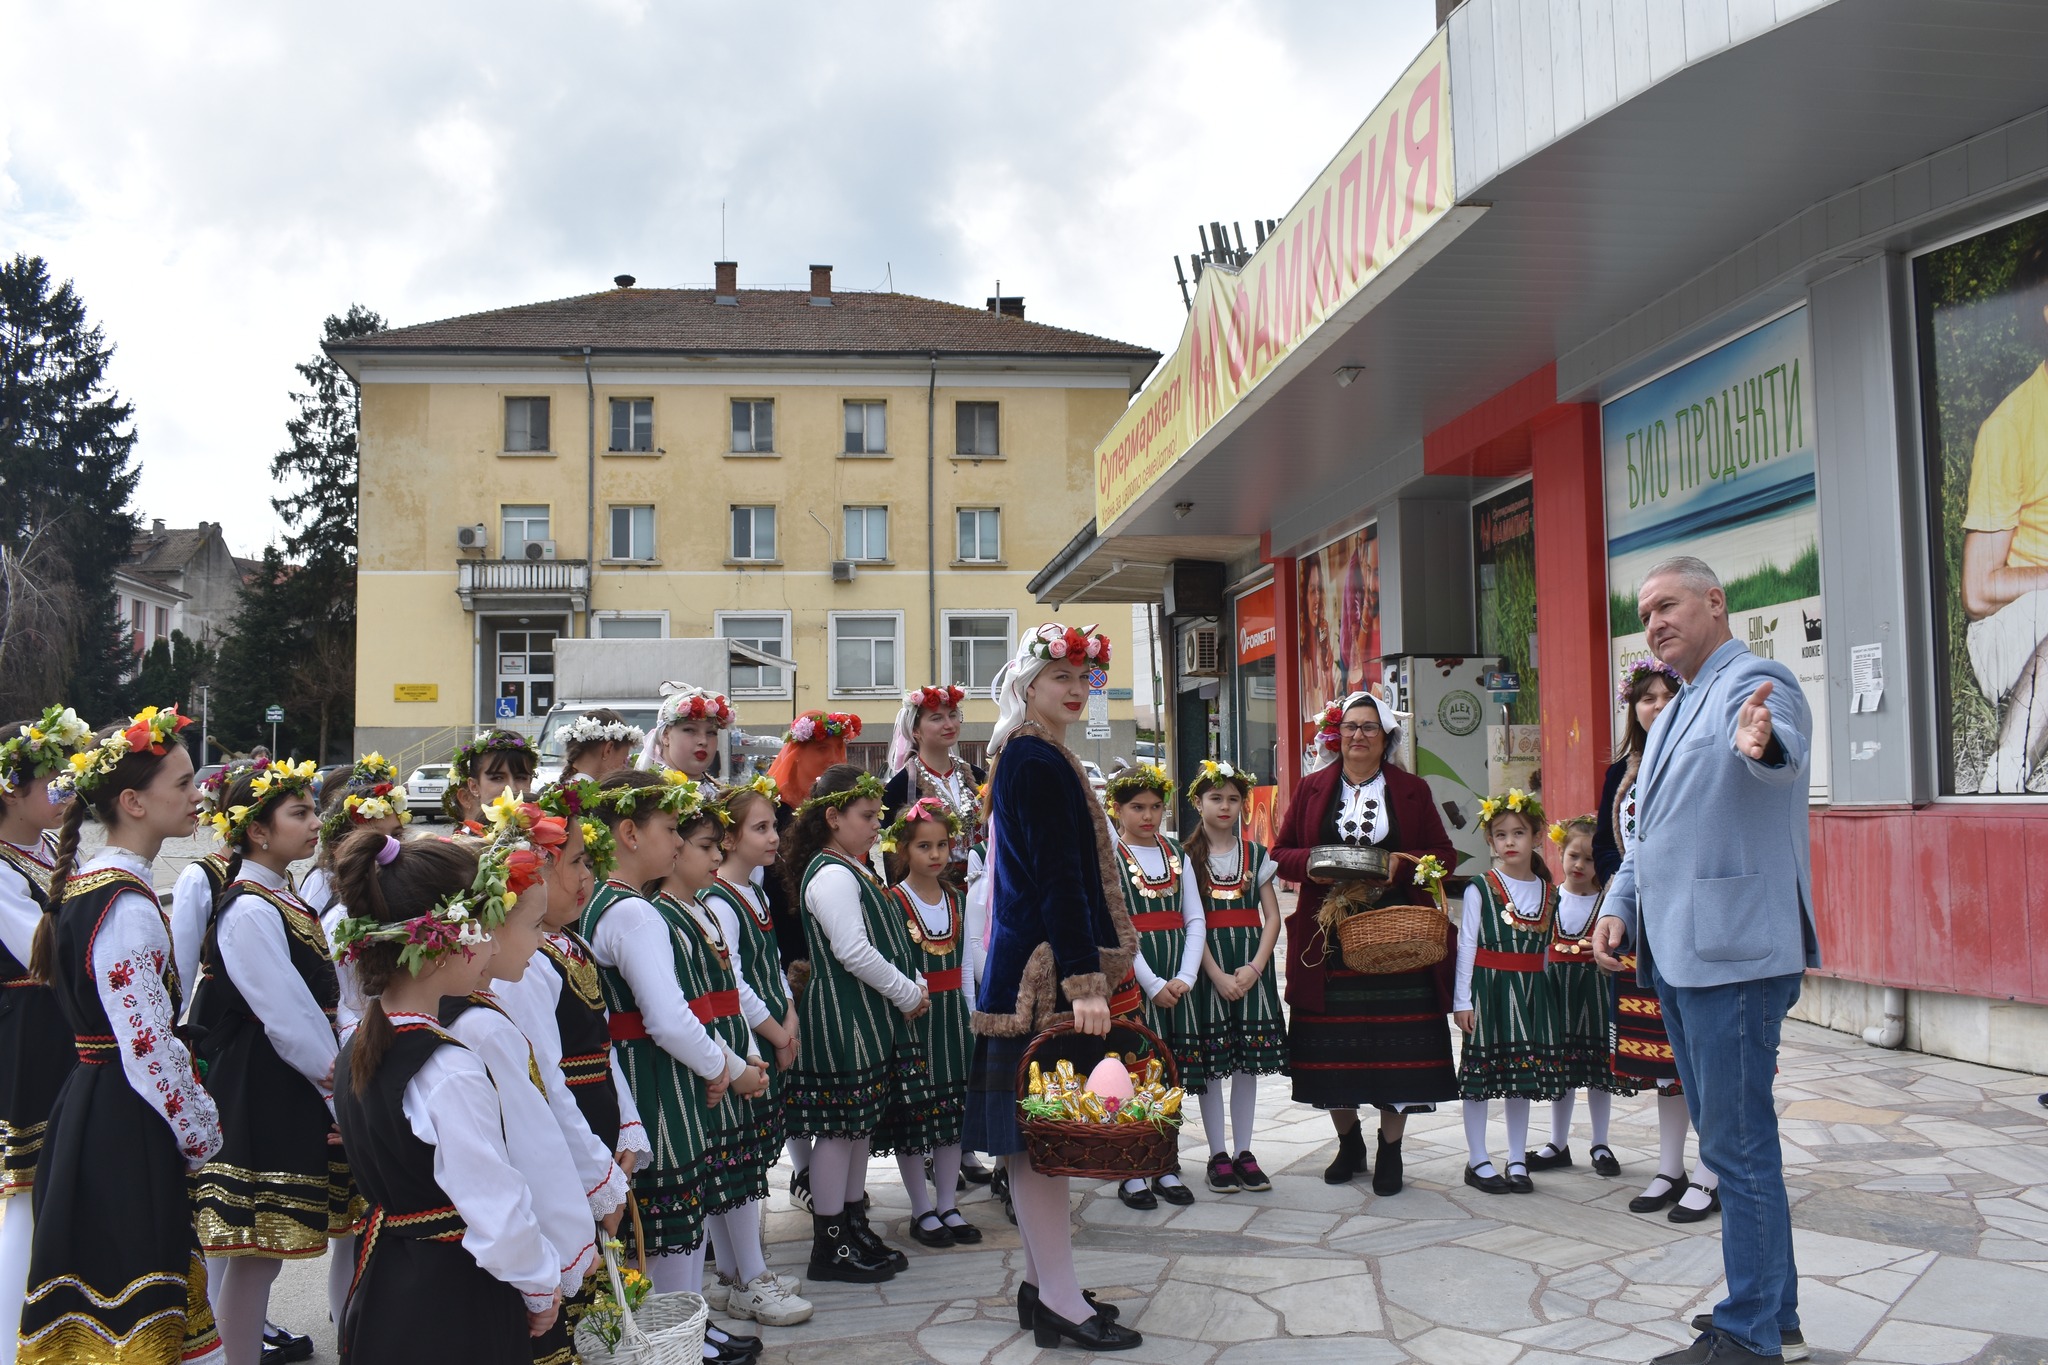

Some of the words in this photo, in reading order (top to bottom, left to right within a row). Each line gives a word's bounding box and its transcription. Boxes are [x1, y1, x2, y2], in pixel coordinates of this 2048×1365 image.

[1227, 61, 1441, 394] ФАМИЛИЯ
[1100, 374, 1181, 501] Супермаркет
[1626, 419, 1669, 510] БИО
[1675, 358, 1803, 491] ПРОДУКТИ
[1450, 702, 1471, 715] ALEX
